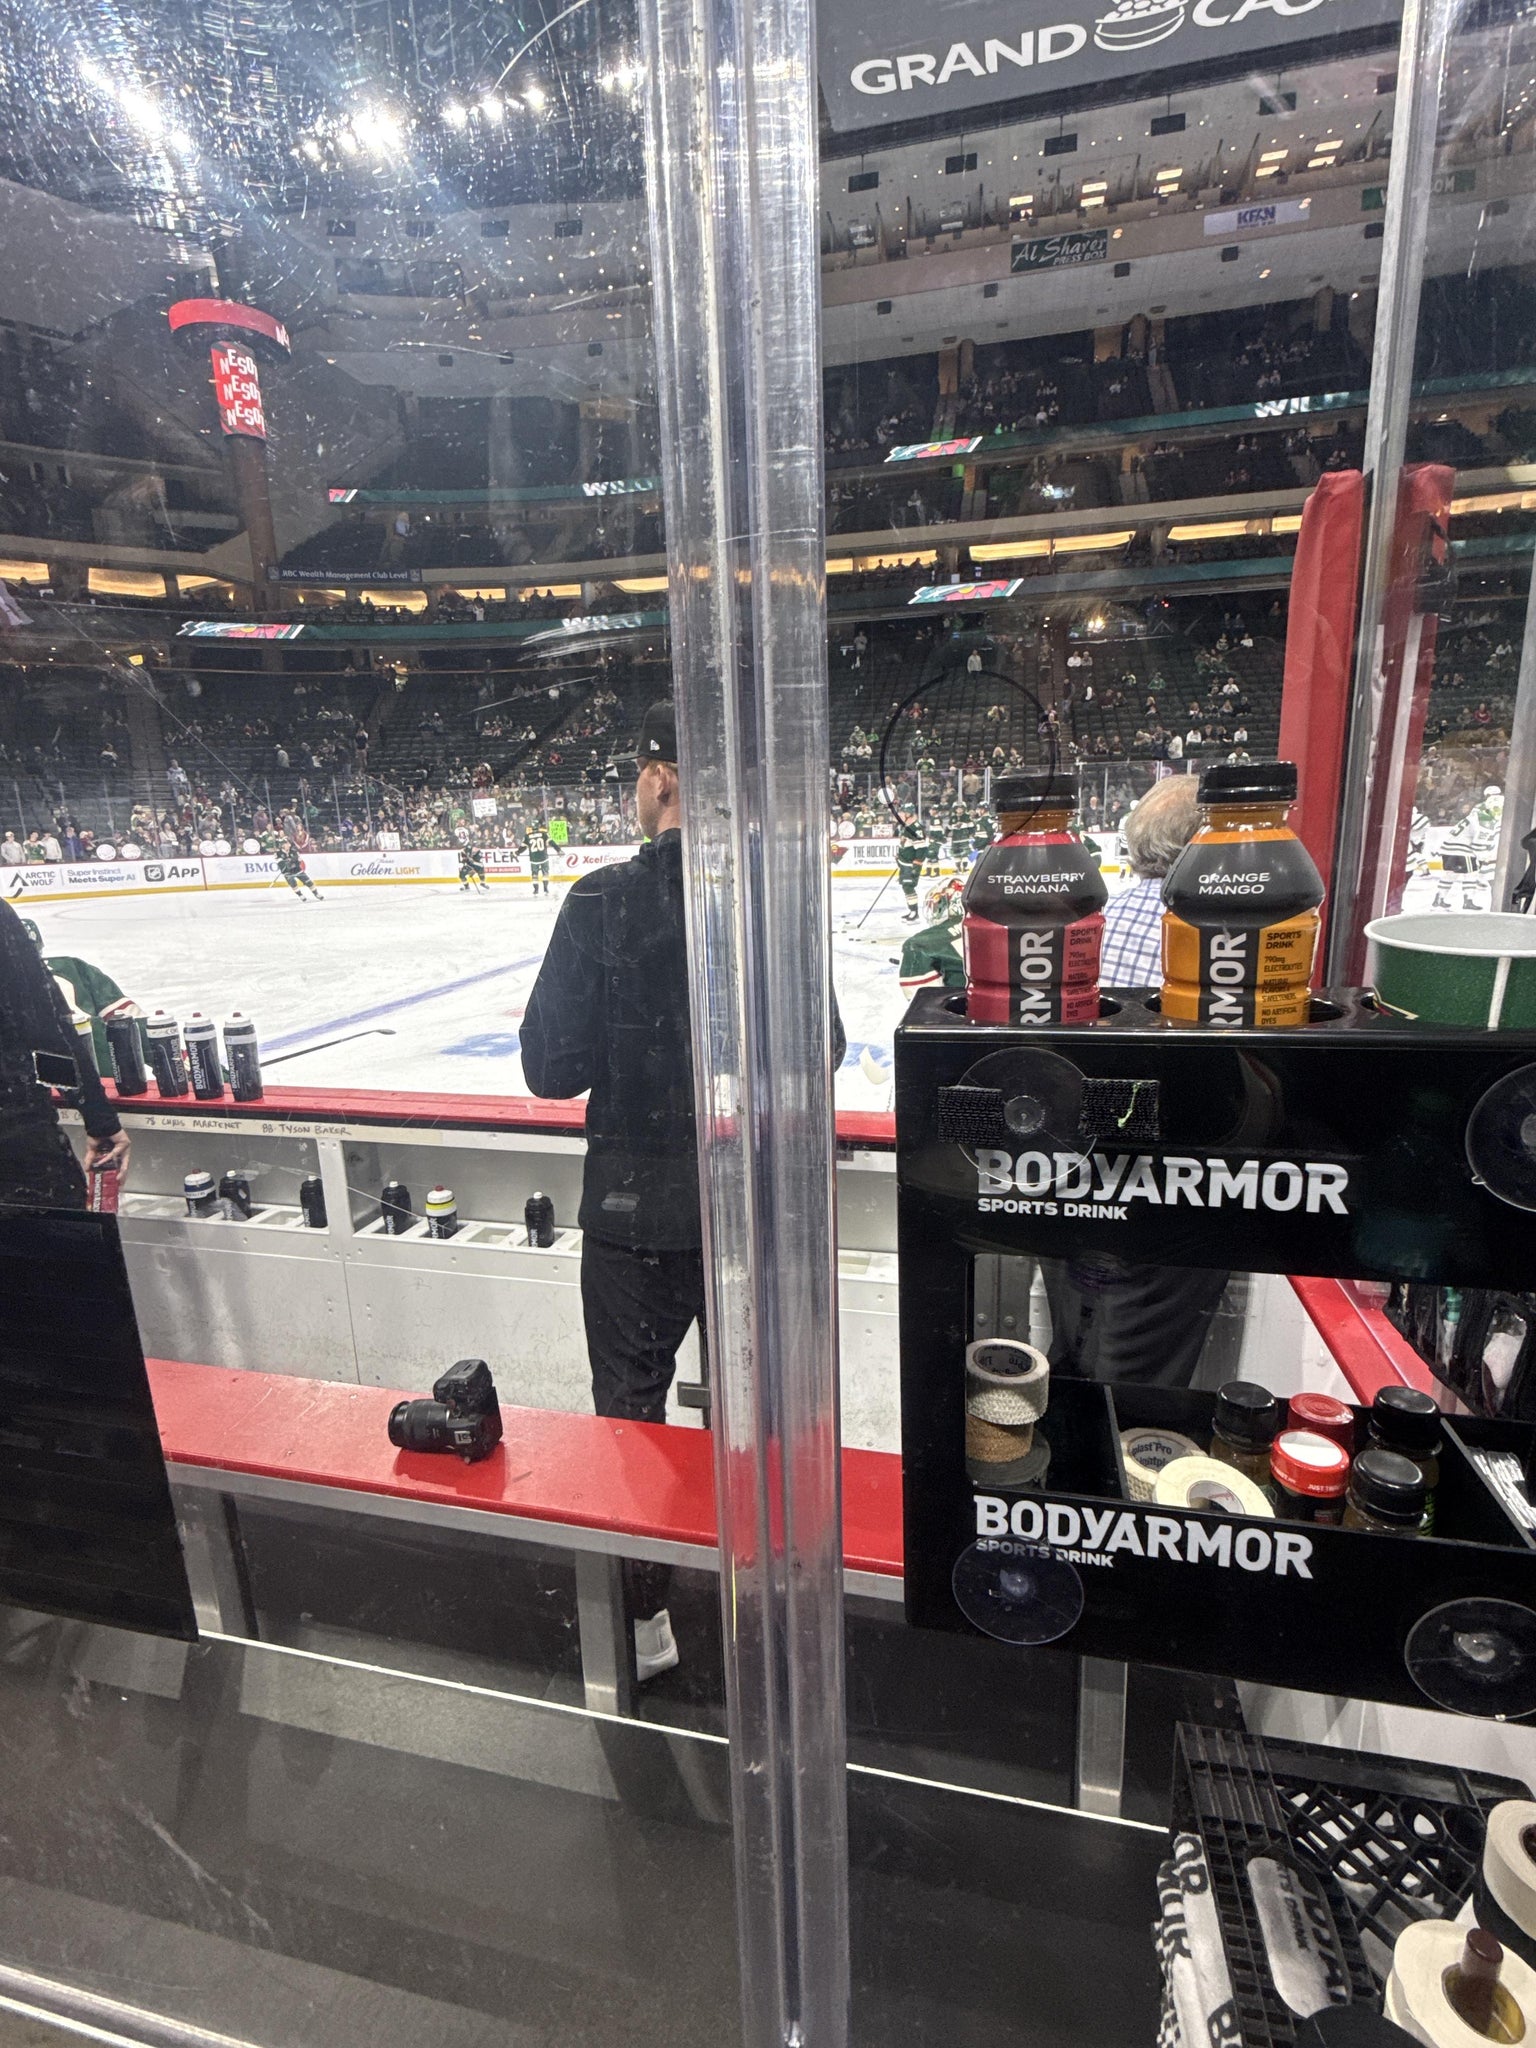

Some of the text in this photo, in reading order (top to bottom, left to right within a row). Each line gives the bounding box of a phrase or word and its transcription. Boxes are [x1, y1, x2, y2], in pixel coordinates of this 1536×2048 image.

[850, 24, 1087, 95] GRAND
[1237, 206, 1276, 224] KFAN
[1012, 237, 1107, 268] Al Shaver
[1053, 249, 1106, 265] PRESS BOX
[299, 570, 324, 578] Wealth
[325, 569, 371, 581] Management
[372, 569, 389, 579] Club
[389, 570, 408, 579] Level
[530, 837, 545, 852] 20
[458, 851, 520, 863] LFLER
[853, 845, 865, 858] THE
[866, 845, 891, 858] HOCKEY
[67, 868, 91, 877] Super
[244, 862, 279, 873] BMO
[350, 863, 421, 876] Golden LIGHT
[25, 870, 56, 879] ARCTIC
[69, 876, 97, 884] Meets
[98, 875, 124, 884] Super
[987, 872, 1085, 884] STRAWBERRY
[1198, 872, 1271, 884] ORANGE
[30, 878, 54, 886] WOLF
[1004, 884, 1070, 894] BANANA
[1198, 884, 1265, 895] MANGO
[1070, 927, 1097, 937] SPORTS
[1266, 931, 1302, 941] SPORTS
[1069, 937, 1092, 946] DRINK
[1265, 940, 1294, 950] DRINK
[1261, 1008, 1271, 1016] NO
[1261, 1017, 1277, 1025] DYES
[188, 1041, 204, 1090] BODYARMOR
[161, 1118, 185, 1127] CHRIS
[279, 1123, 310, 1134] TYSON
[314, 1125, 352, 1136] BAKER
[975, 1148, 1349, 1215] BODYARMOR
[977, 1198, 1128, 1221] SPORTS DRINK
[1153, 1442, 1172, 1455] Pro
[973, 1494, 1314, 1580] BODYARMOR
[976, 1539, 1114, 1569] SPORTS DRINK
